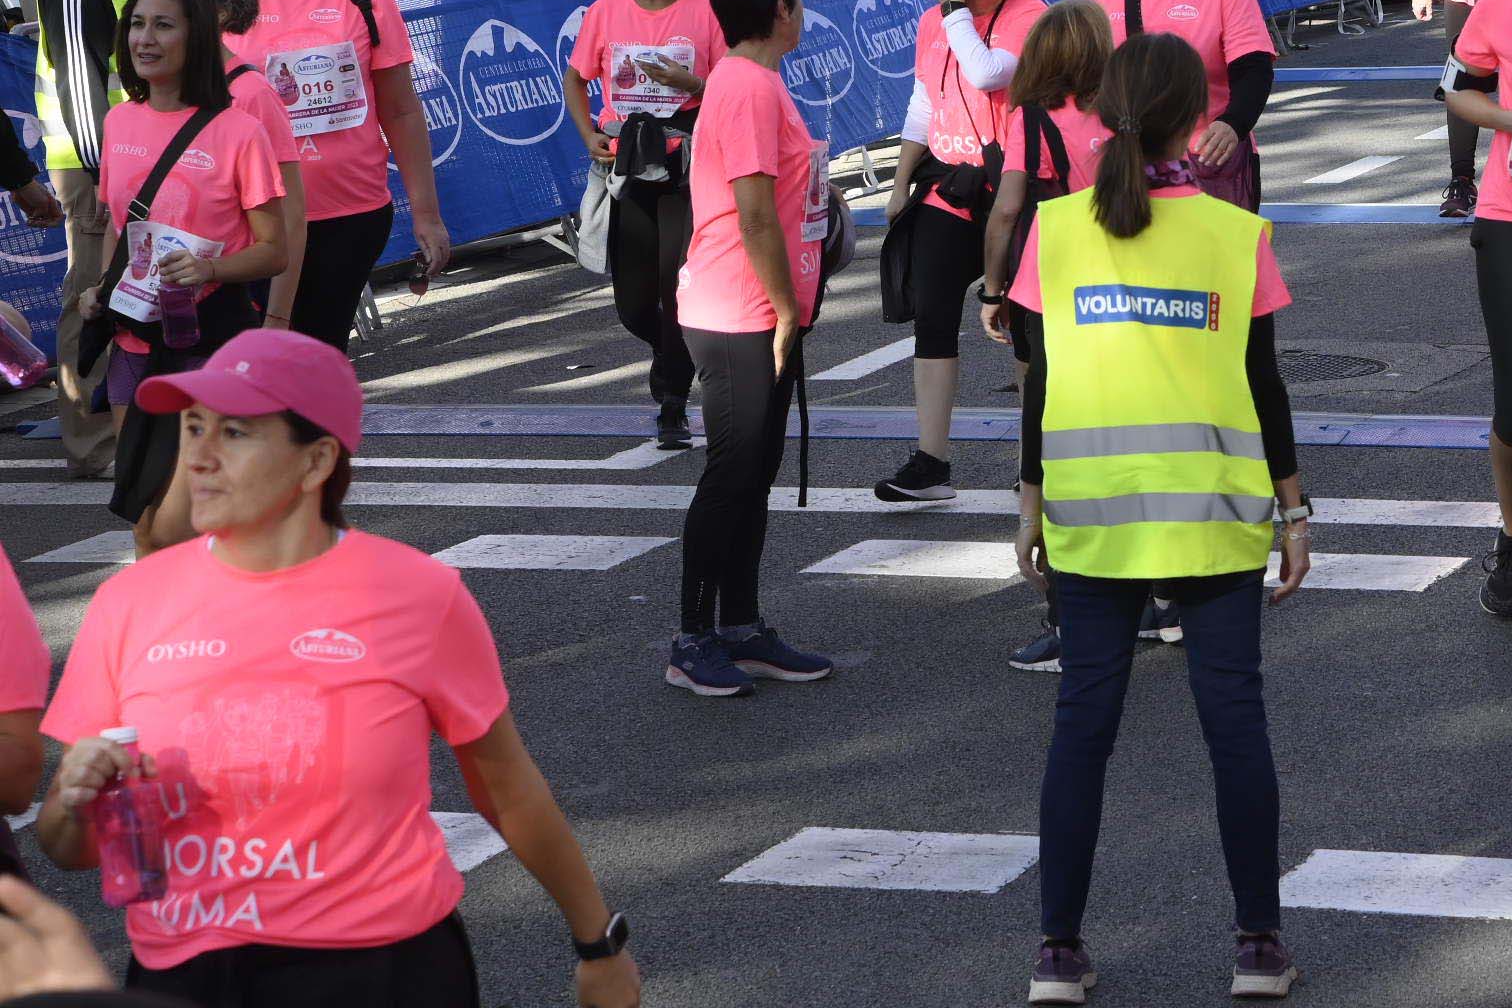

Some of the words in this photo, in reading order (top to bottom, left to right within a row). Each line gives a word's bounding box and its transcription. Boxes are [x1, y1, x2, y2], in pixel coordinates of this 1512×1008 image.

[478, 64, 511, 78] CENTRAL
[302, 80, 334, 96] 016
[471, 71, 560, 120] ASTURIANA
[112, 143, 148, 158] OYSHO
[1077, 295, 1205, 320] VOLUNTARIS
[147, 638, 226, 663] OYSHO
